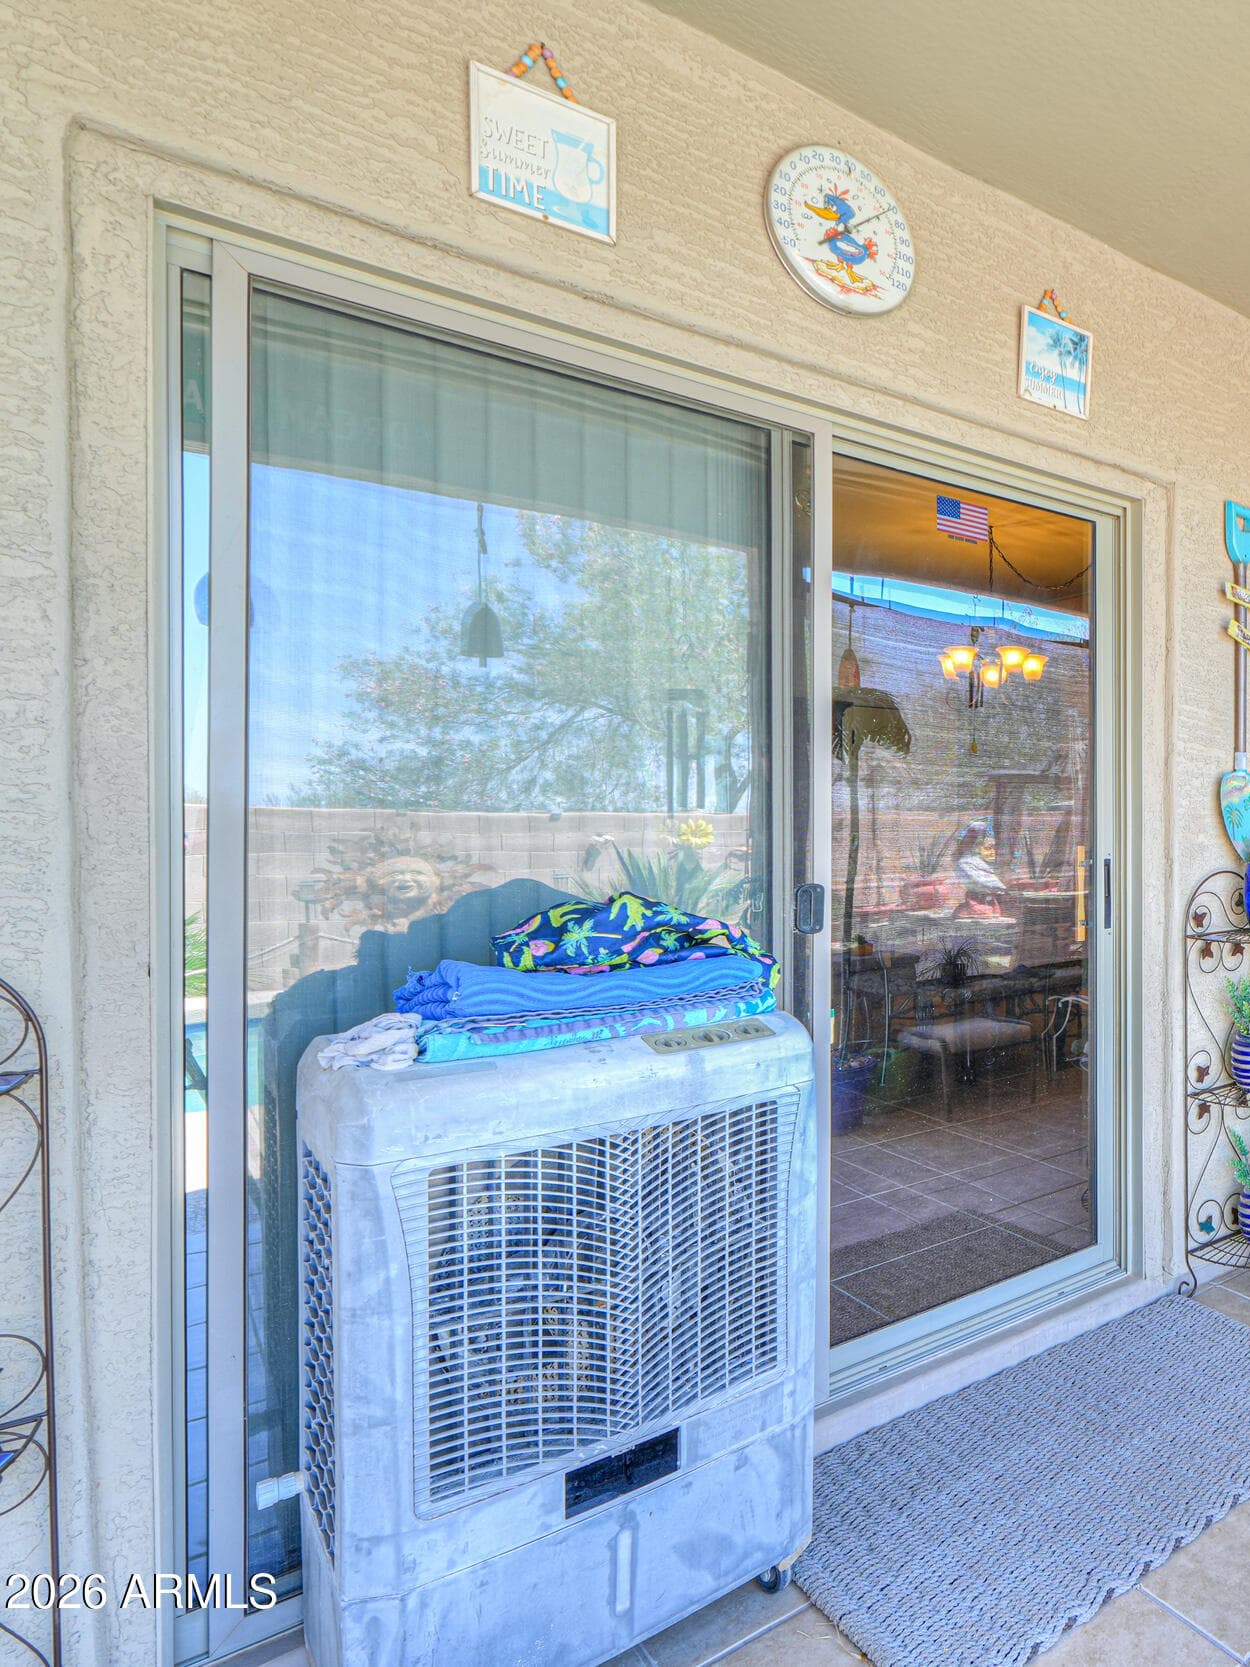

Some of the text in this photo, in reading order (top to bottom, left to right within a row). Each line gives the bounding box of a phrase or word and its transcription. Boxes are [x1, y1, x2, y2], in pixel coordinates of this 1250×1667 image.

[484, 117, 549, 159] SWEET
[799, 152, 811, 165] 10
[811, 150, 825, 163] 20
[829, 152, 842, 166] 30
[790, 161, 797, 170] 0
[485, 165, 547, 211] TIME
[773, 183, 787, 196] 20
[874, 185, 886, 198] 60
[773, 200, 787, 213] 30
[776, 217, 791, 229] 40
[894, 219, 906, 232] 80
[783, 235, 797, 248] 50
[899, 236, 910, 248] 90
[898, 251, 914, 265] 100
[891, 277, 908, 292] 120
